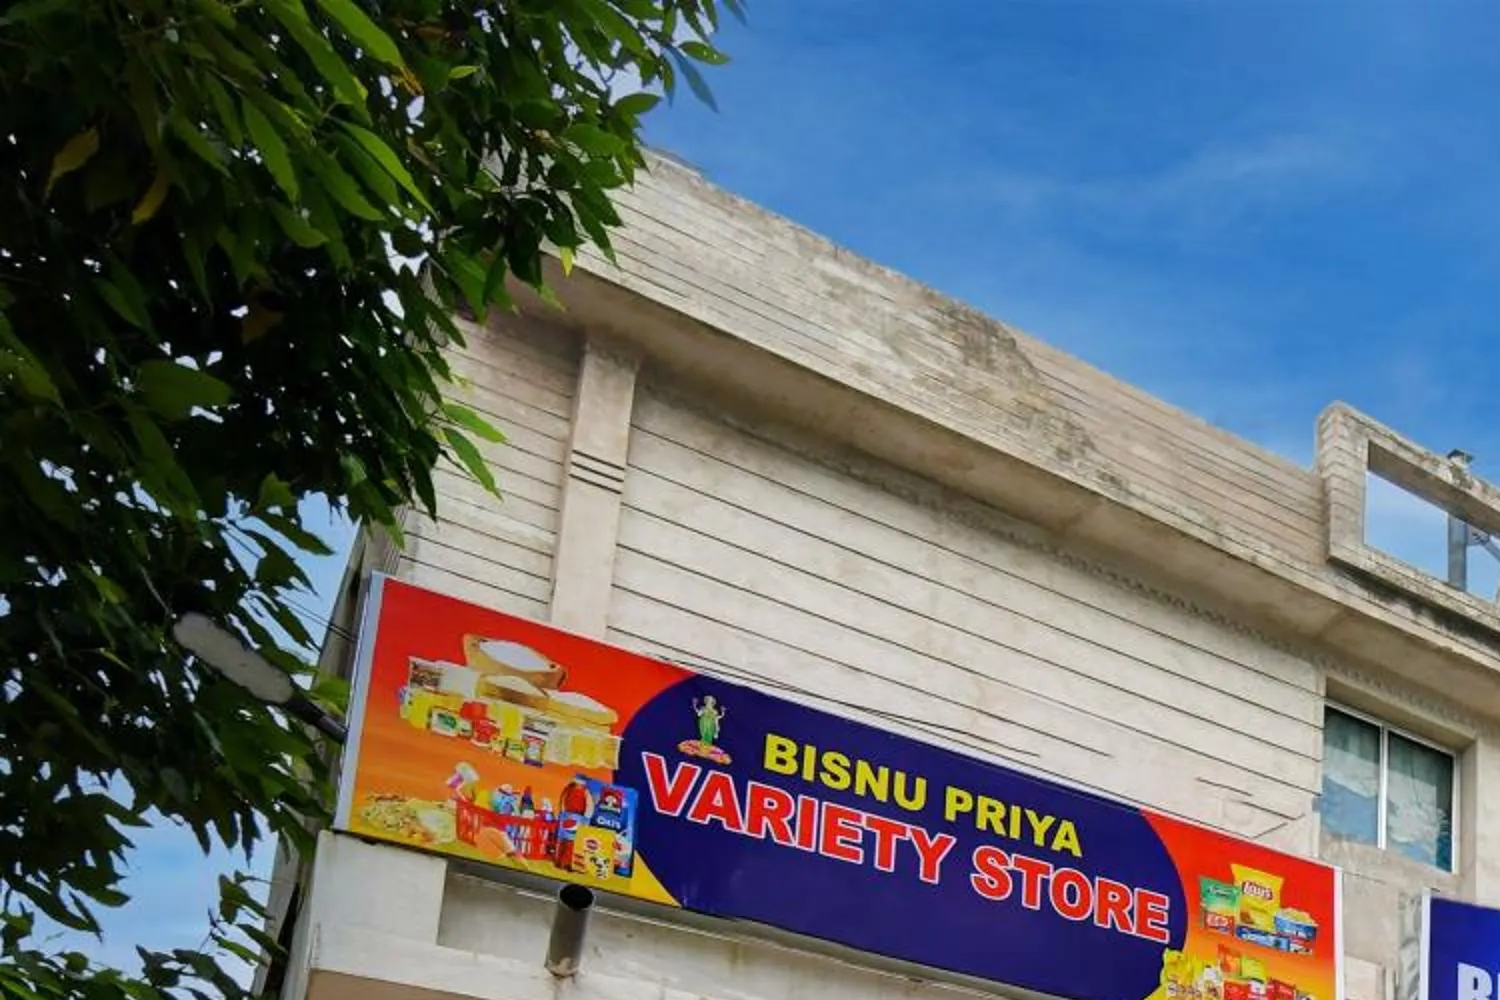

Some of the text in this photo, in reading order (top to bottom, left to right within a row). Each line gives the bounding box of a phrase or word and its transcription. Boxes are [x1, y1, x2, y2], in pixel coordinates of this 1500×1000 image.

[642, 751, 1171, 944] VARIETY STORE
[762, 733, 1083, 857] BISNU PRIYA
